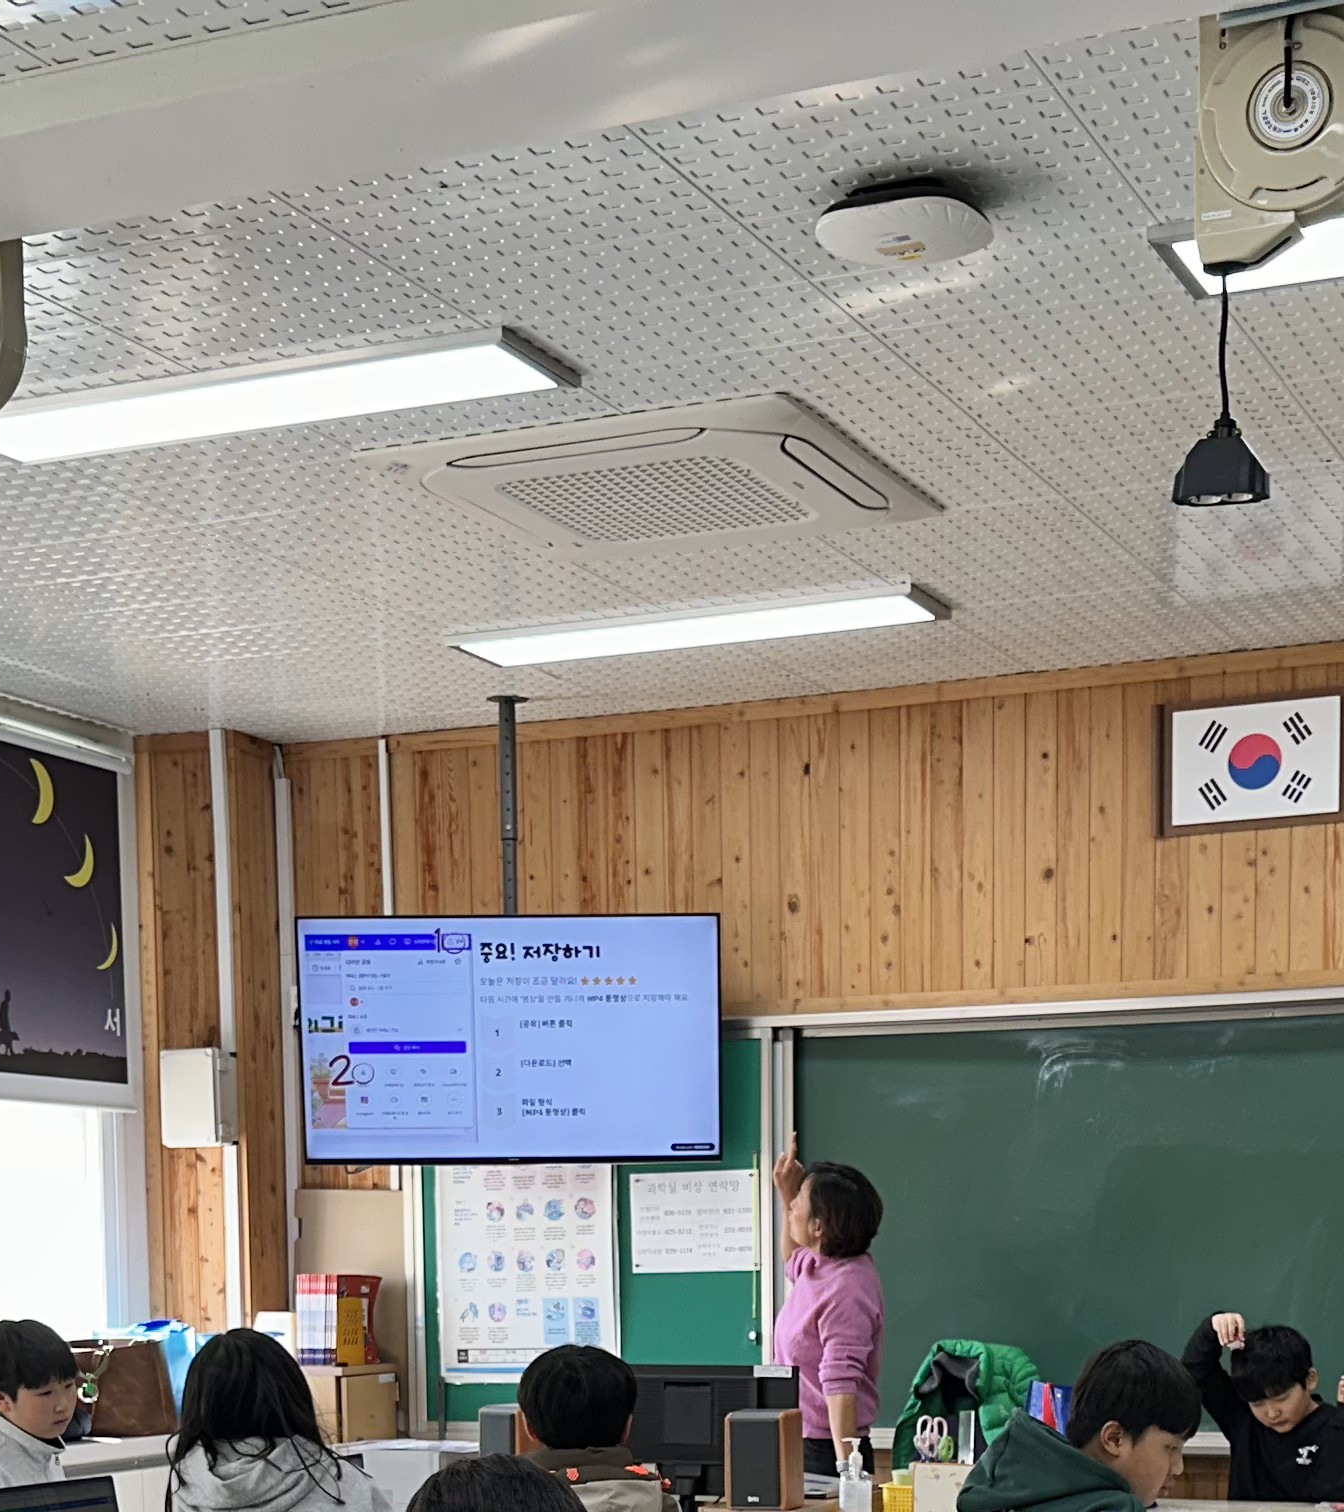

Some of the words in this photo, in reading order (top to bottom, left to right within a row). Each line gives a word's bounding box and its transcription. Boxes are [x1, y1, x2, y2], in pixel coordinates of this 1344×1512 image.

[479, 942, 516, 964] 중요!
[522, 942, 601, 962] 저장하기
[479, 976, 504, 987] 오늘은
[104, 1008, 121, 1037] 서
[328, 1054, 355, 1087] 2
[495, 1068, 502, 1078] 2
[496, 1107, 503, 1117] 3
